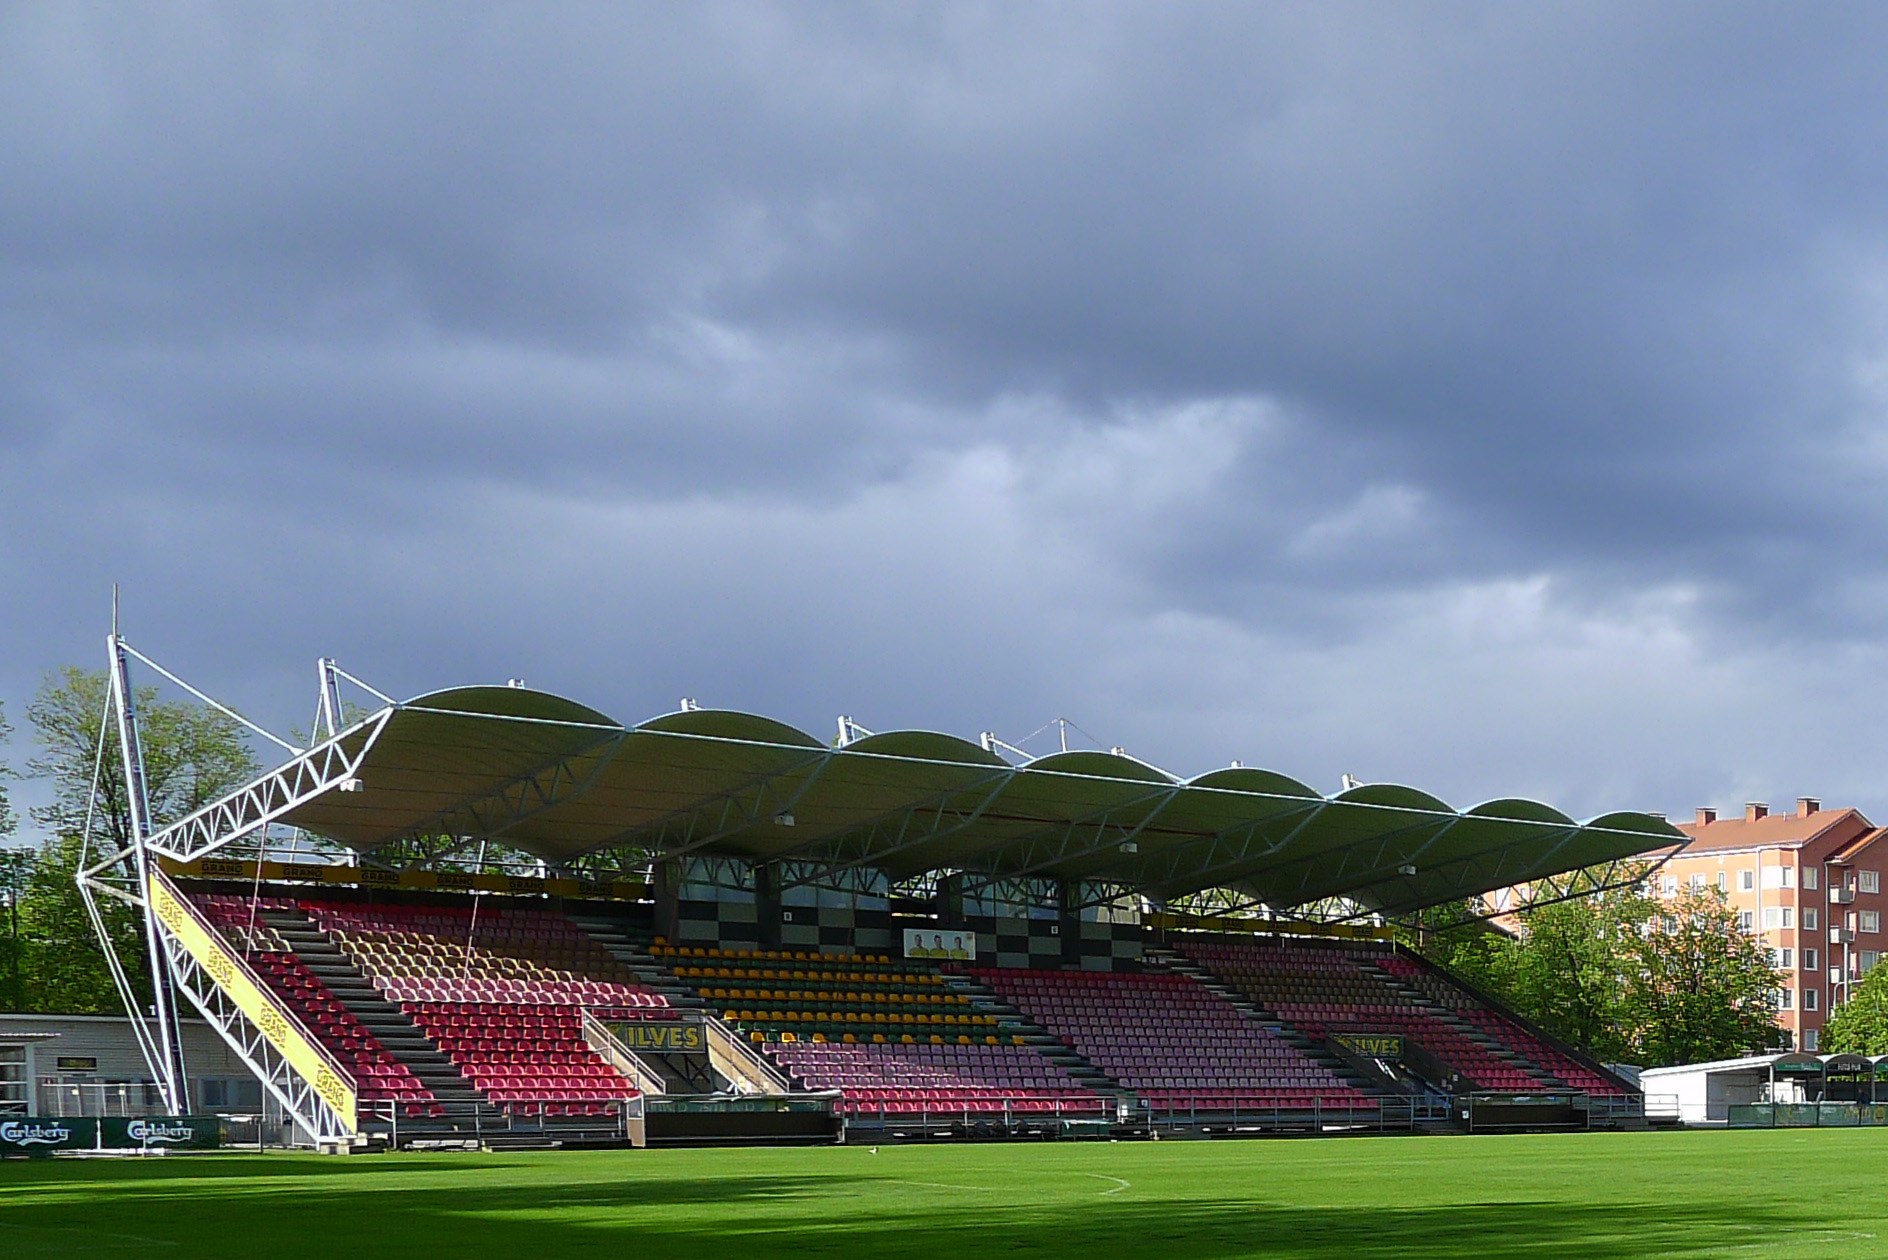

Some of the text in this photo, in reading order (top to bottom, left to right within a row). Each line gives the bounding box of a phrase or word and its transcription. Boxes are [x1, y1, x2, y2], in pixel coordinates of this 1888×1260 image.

[201, 862, 244, 874] GRANO
[282, 867, 324, 878] GRANO
[361, 871, 401, 881] GRANO
[626, 1026, 699, 1048] ILVES
[1355, 1038, 1400, 1055] ILVES
[0, 1121, 72, 1142] Carlsberg
[127, 1120, 195, 1141] Carlsberg
